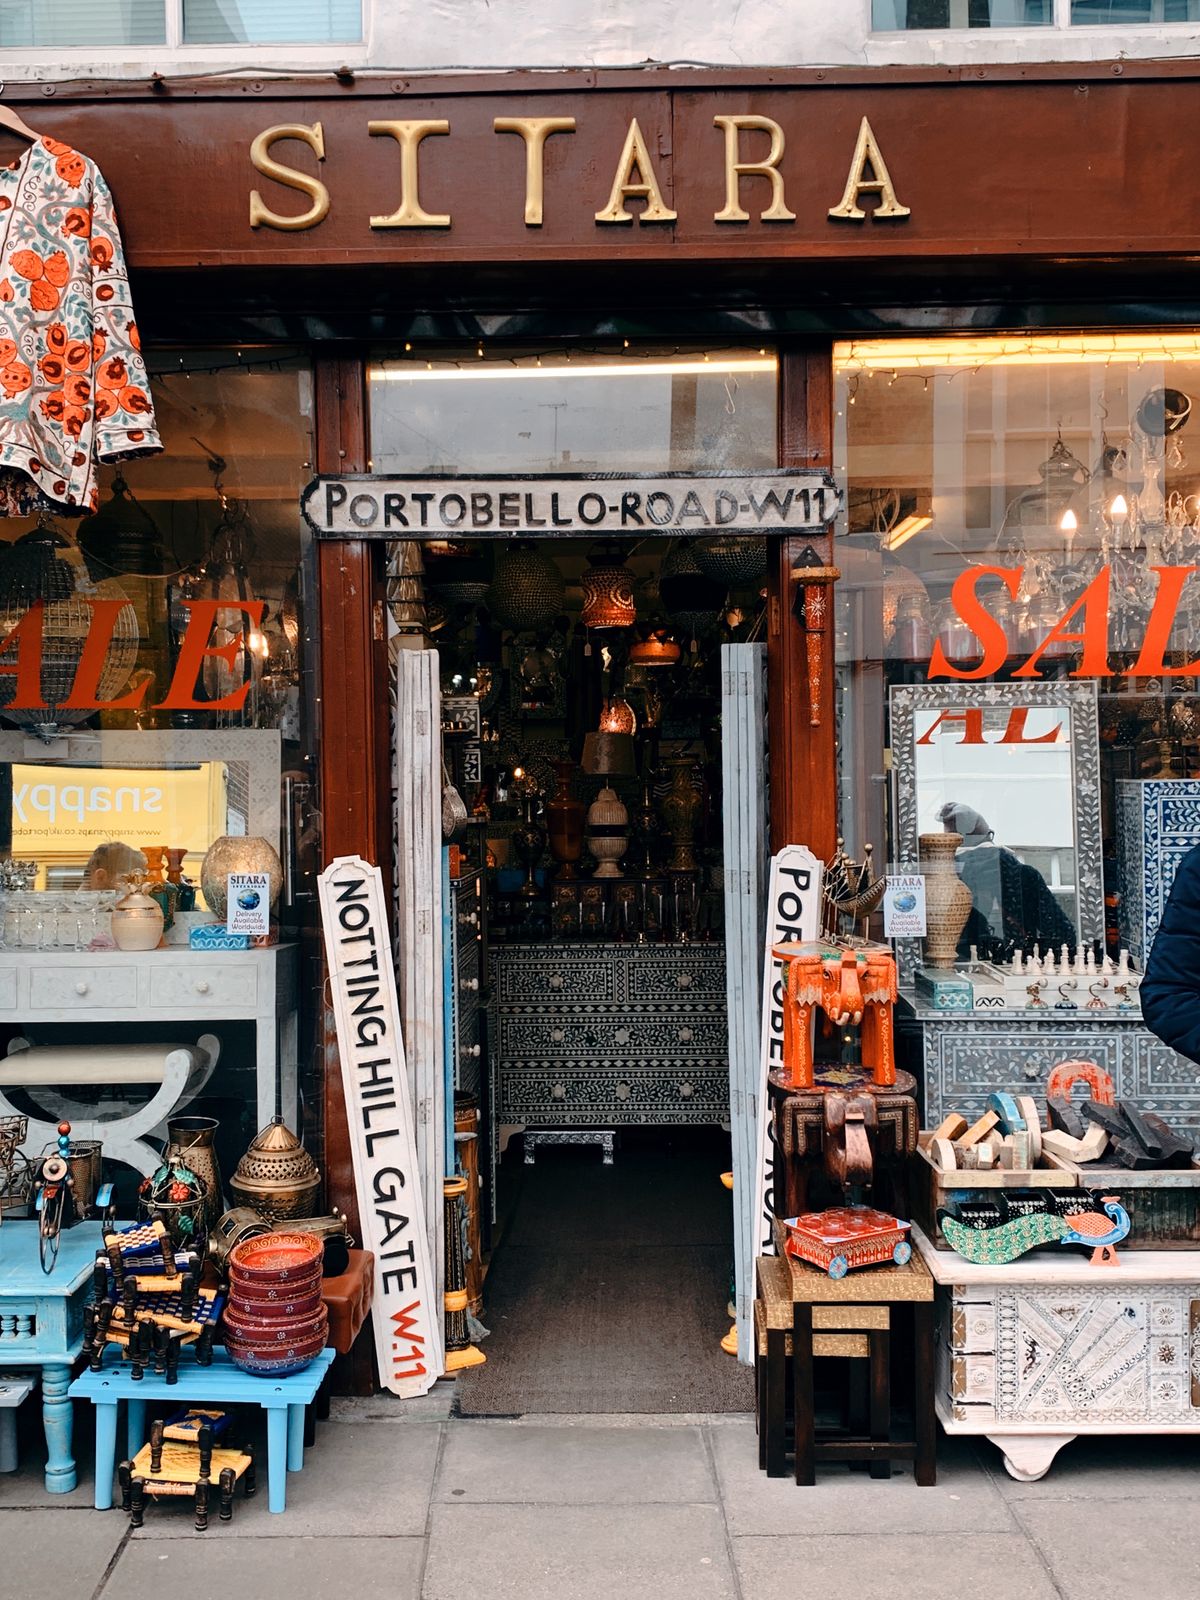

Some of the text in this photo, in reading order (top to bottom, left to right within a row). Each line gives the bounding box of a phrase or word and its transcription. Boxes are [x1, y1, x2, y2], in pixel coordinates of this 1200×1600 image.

[249, 114, 911, 231] SITARA
[230, 875, 267, 884] SITARA
[886, 877, 922, 887] SITARA
[333, 879, 427, 1380] NOTTING HILL GATE W.11
